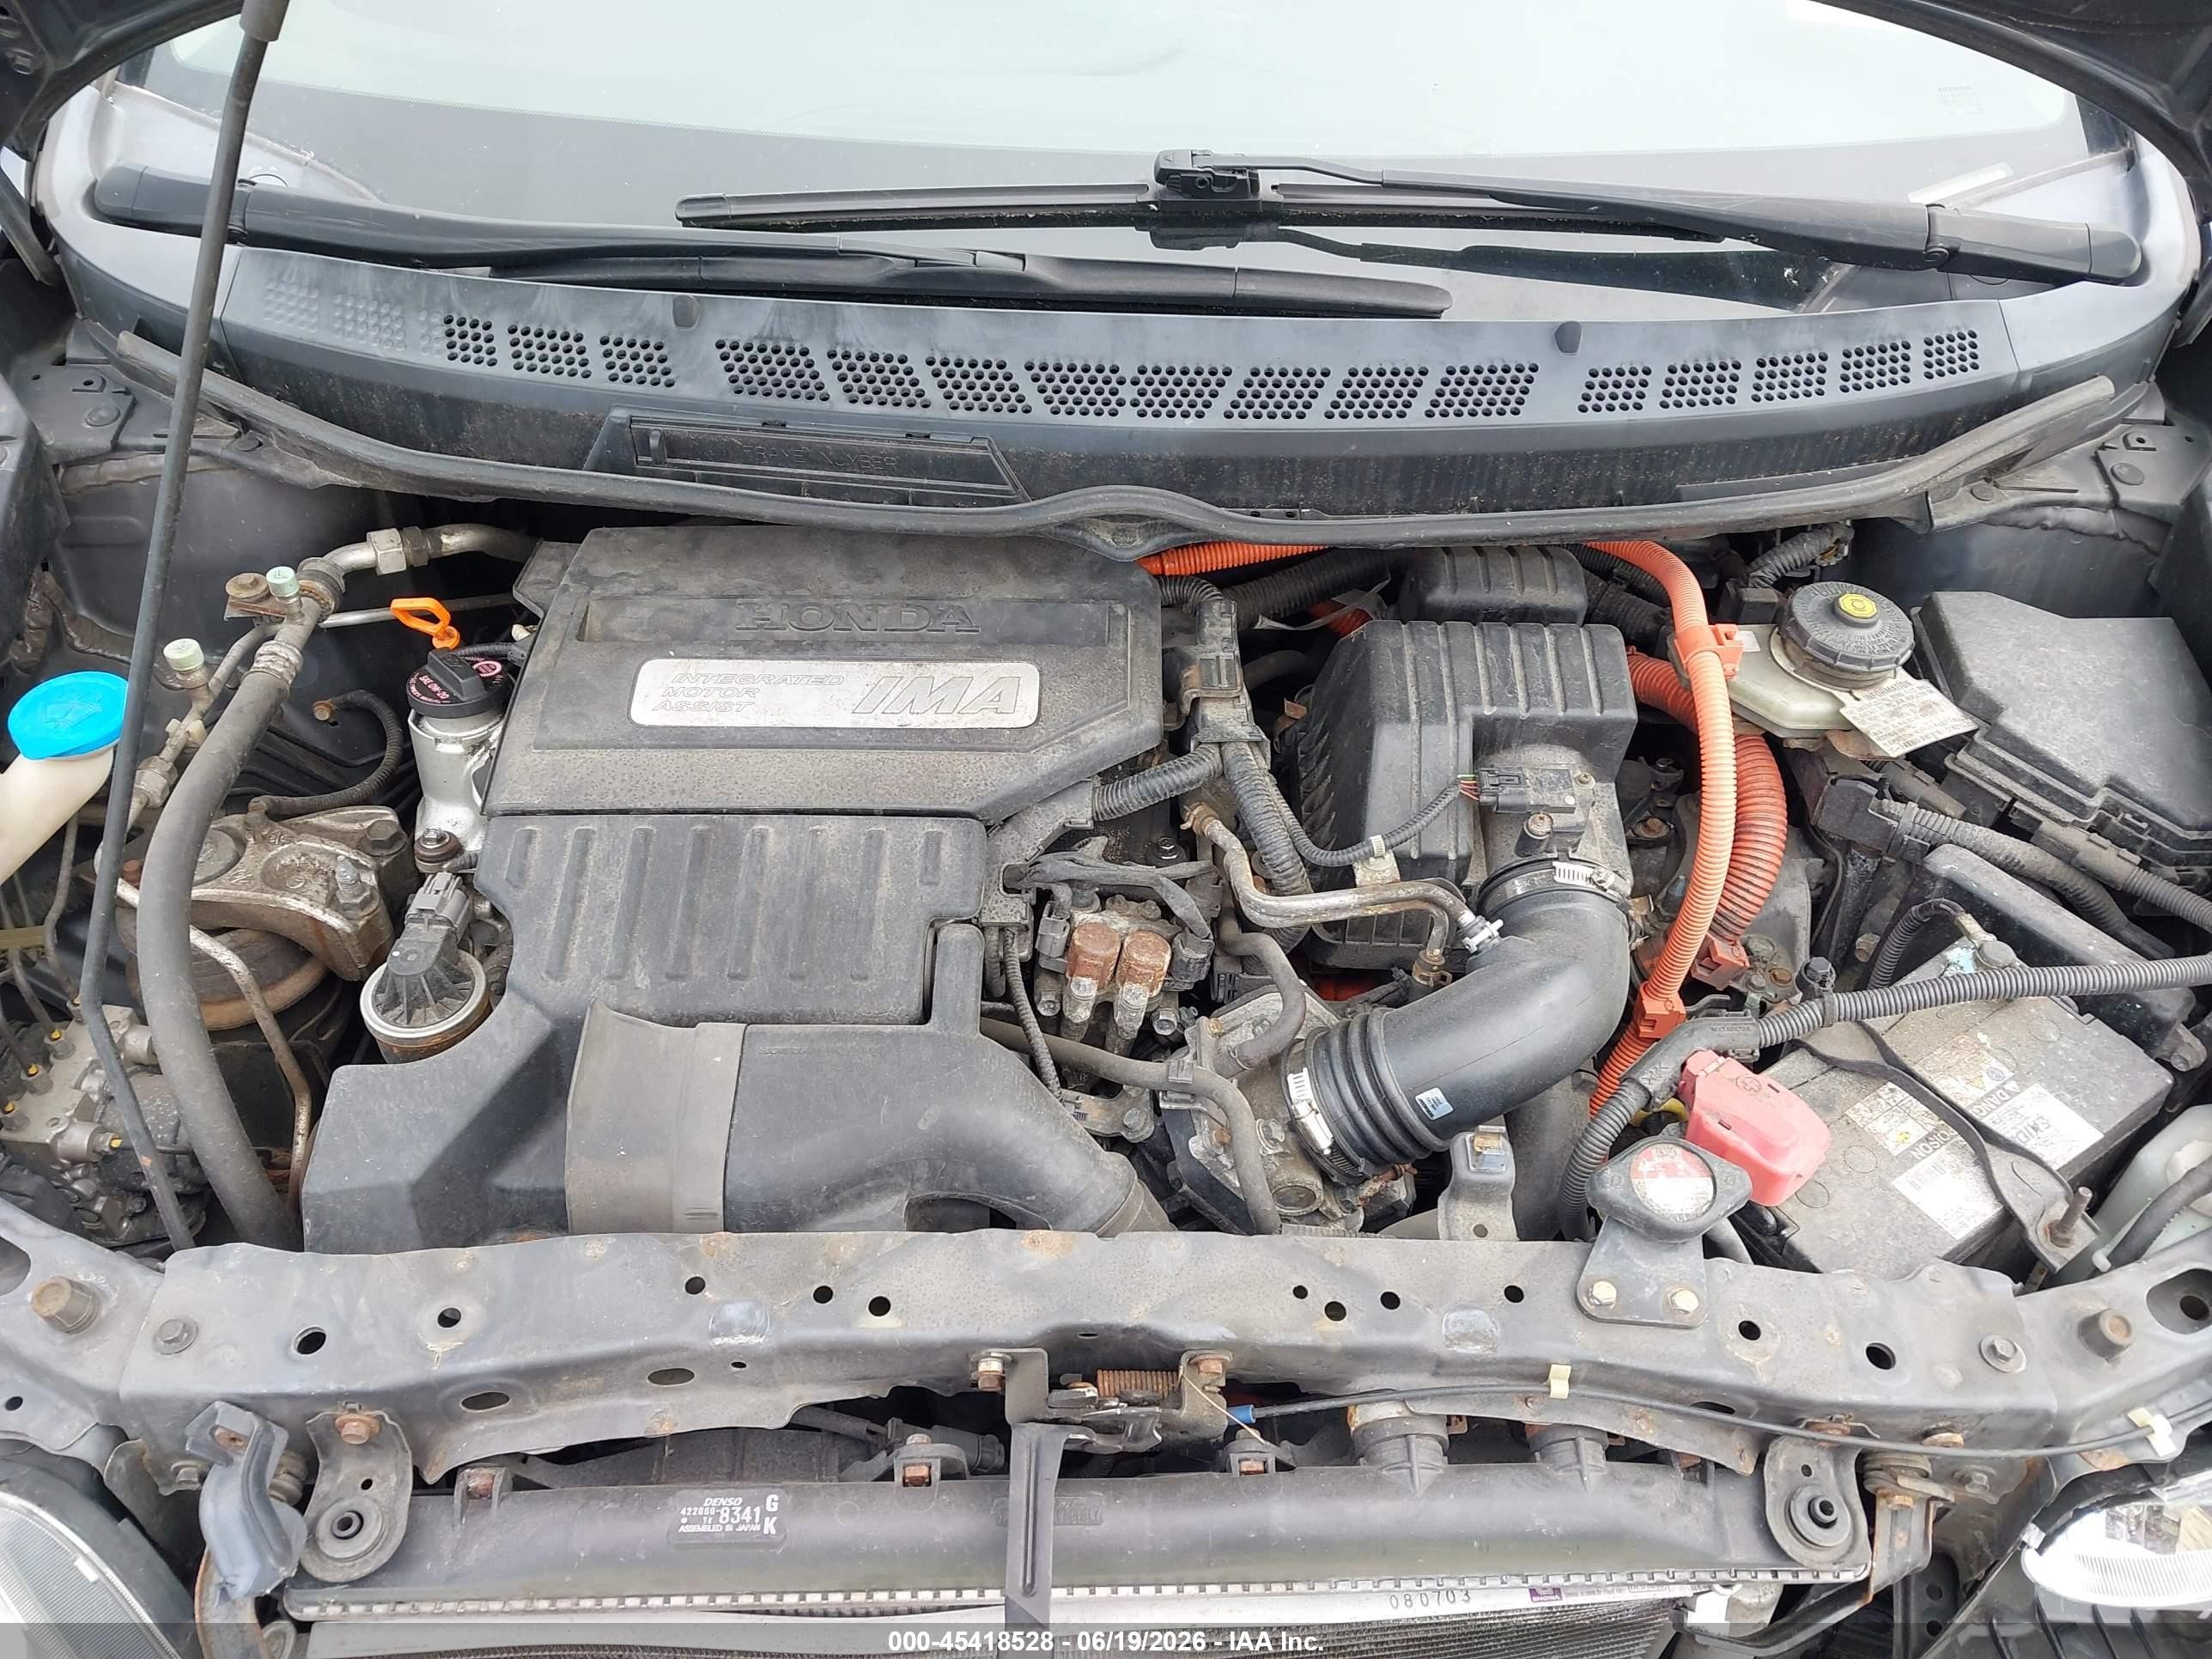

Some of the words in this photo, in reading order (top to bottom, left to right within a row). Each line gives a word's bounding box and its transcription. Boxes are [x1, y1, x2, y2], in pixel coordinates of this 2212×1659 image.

[735, 602, 981, 633] HONDA
[418, 674, 433, 688] SAE
[671, 672, 847, 686] INTEGRATED
[661, 687, 760, 699] MOTOR
[852, 676, 1021, 714] IMA
[1863, 678, 1913, 702] INFORMATION
[653, 702, 756, 713] ASSIST
[1968, 1089, 2012, 1119] DANG
[703, 1498, 743, 1507] DENSO
[765, 1494, 779, 1512] G
[678, 1524, 722, 1533] ASSEMBLED
[735, 1523, 762, 1532] JAPAN
[763, 1516, 777, 1534] K
[1389, 1589, 1471, 1609] 080703
